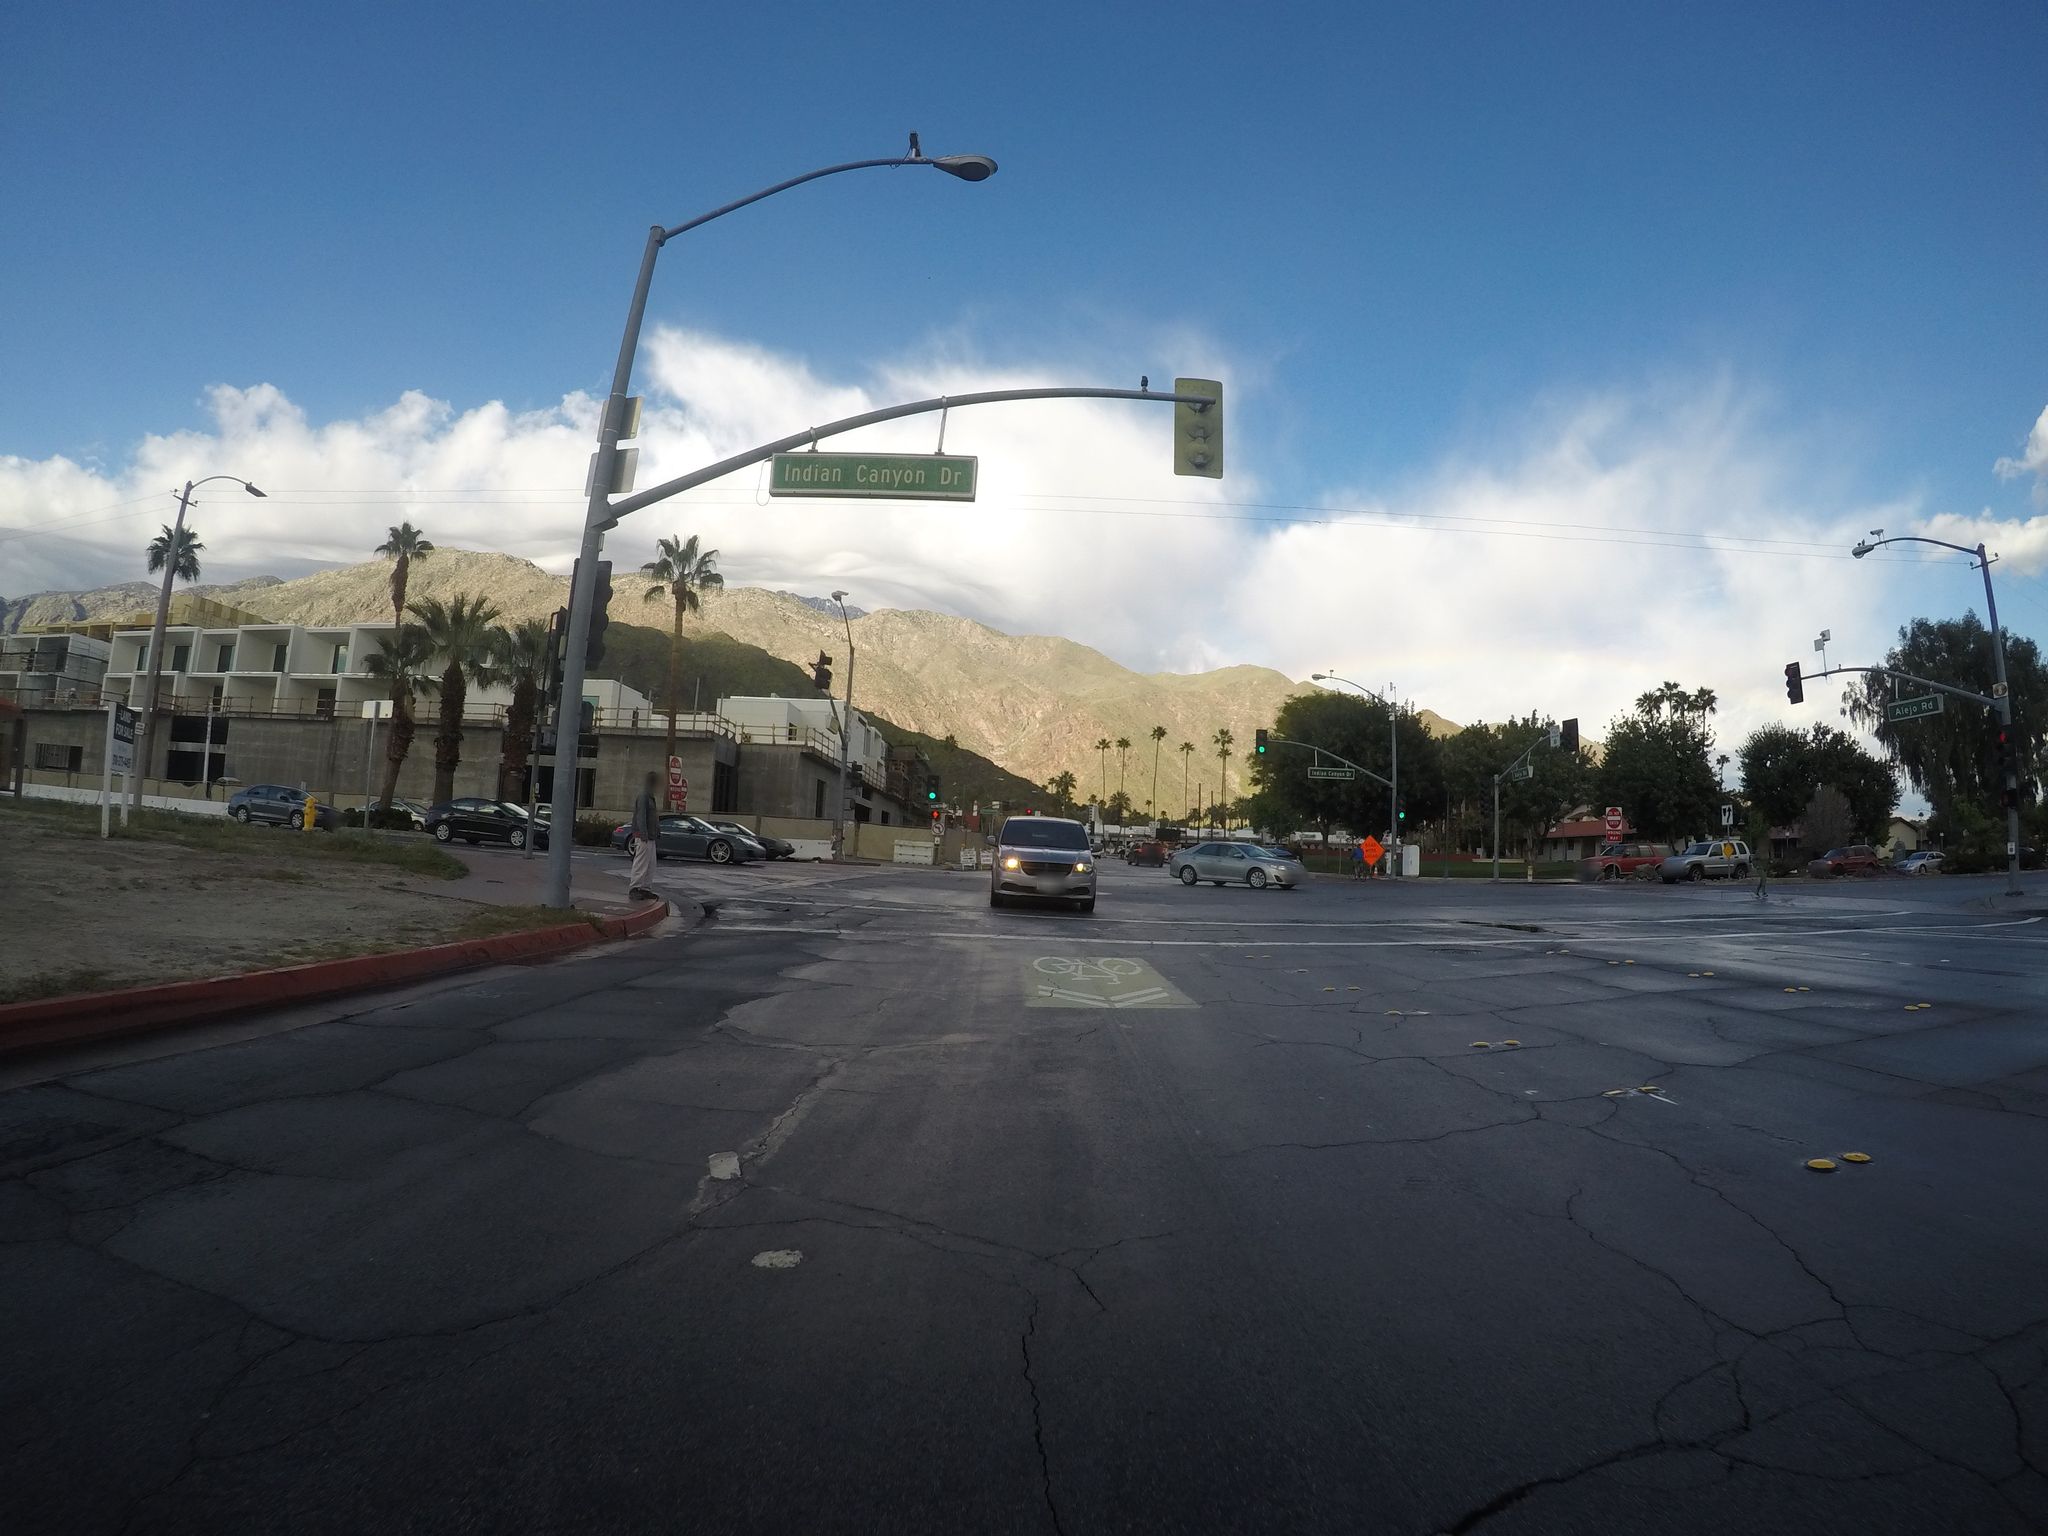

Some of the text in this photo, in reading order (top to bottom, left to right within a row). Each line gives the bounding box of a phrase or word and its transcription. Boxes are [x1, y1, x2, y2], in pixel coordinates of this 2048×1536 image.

[784, 463, 962, 487] Indian Canyon Dr
[1895, 702, 1934, 716] Alejo Rd
